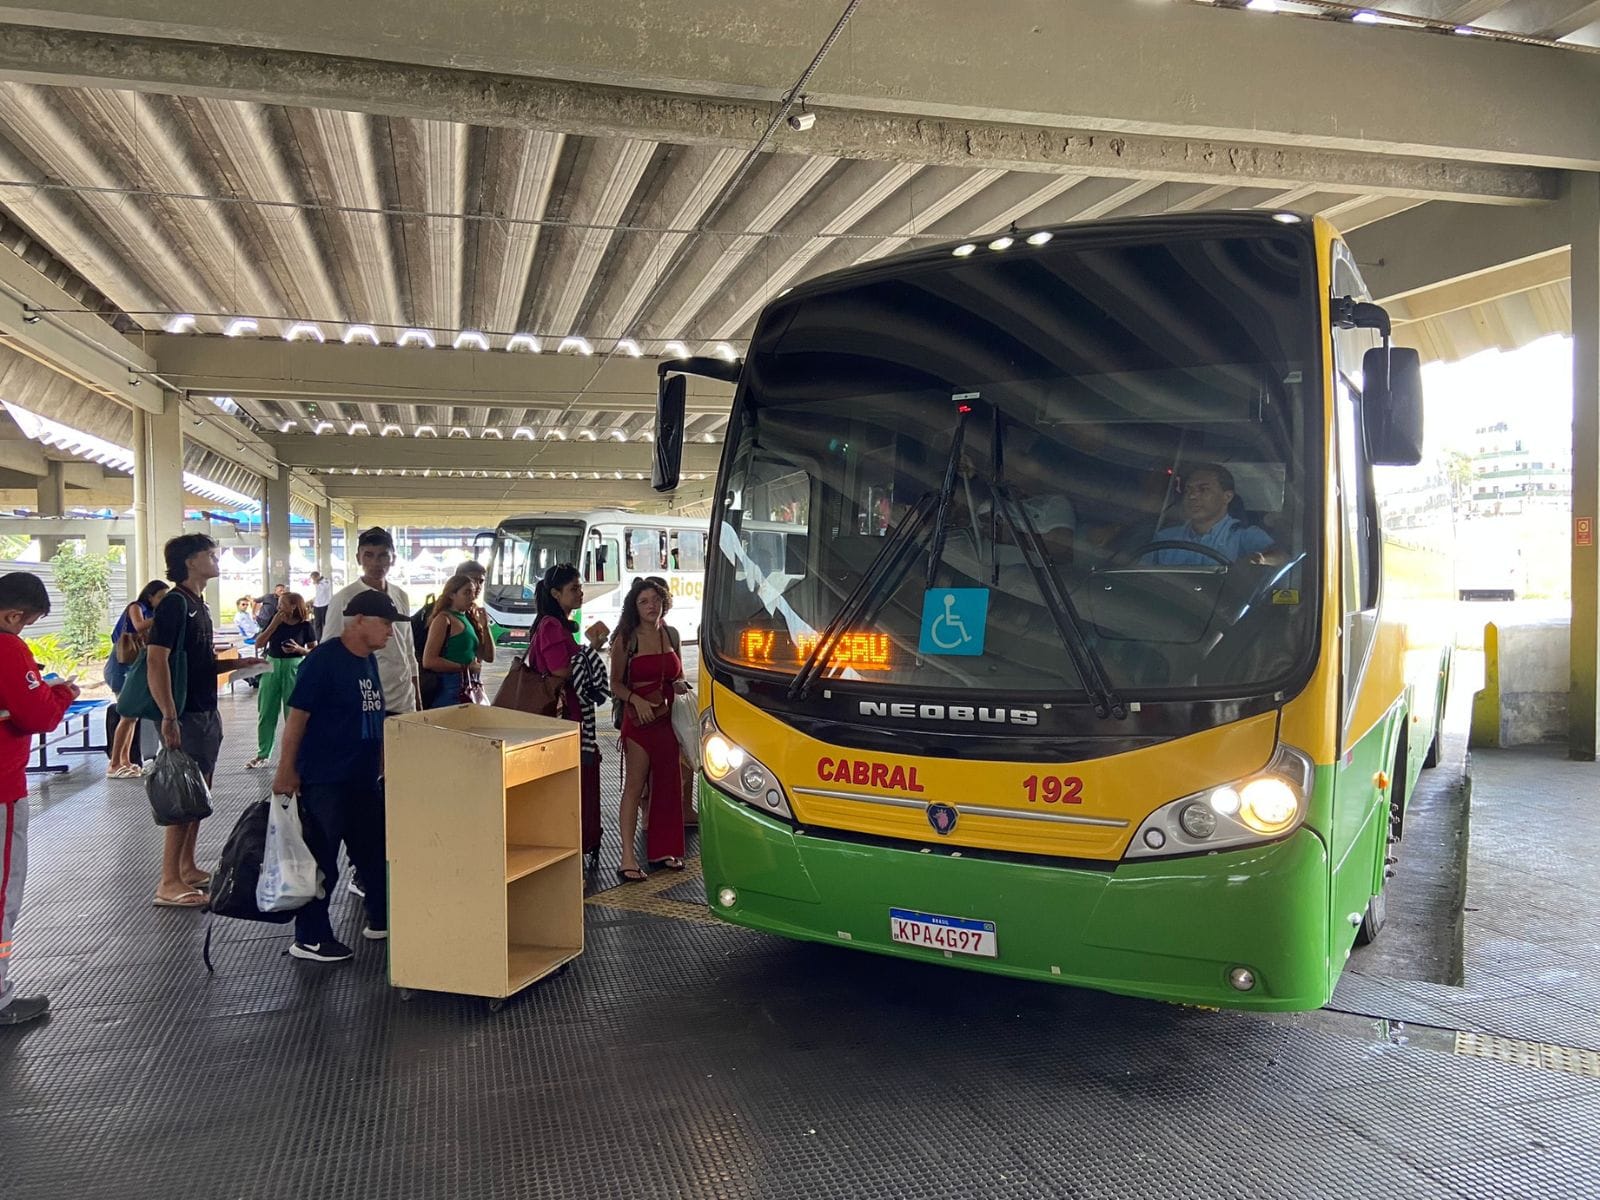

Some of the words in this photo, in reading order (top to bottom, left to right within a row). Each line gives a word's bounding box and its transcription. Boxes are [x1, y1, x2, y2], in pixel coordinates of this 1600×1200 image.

[748, 631, 774, 661] P/
[359, 679, 372, 689] NO
[361, 690, 380, 700] VEM
[859, 701, 1038, 725] NEOBUS
[817, 757, 924, 792] CABRAL
[1023, 775, 1083, 804] 192
[899, 921, 982, 951] KPA4G97
